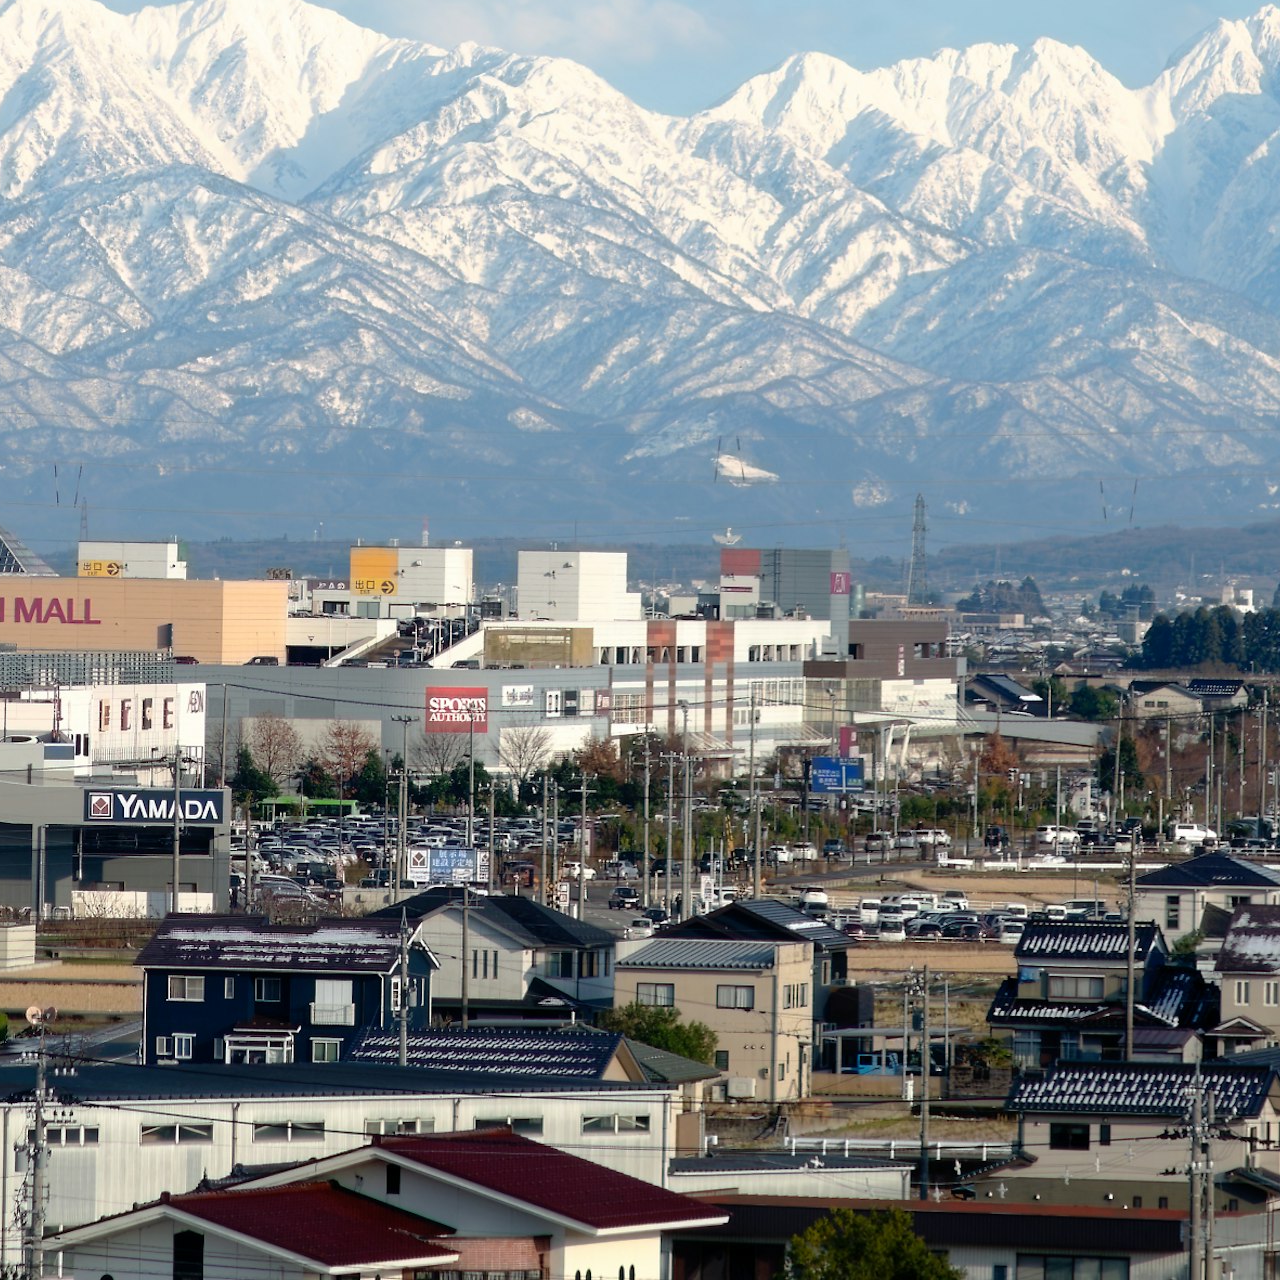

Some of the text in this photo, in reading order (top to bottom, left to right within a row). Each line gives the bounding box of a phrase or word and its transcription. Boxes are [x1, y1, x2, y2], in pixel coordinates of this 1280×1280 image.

[83, 562, 102, 571] 出口
[355, 580, 375, 590] 出口
[14, 596, 101, 624] MALL
[429, 697, 486, 713] SPORTS
[117, 793, 219, 820] YAMADA
